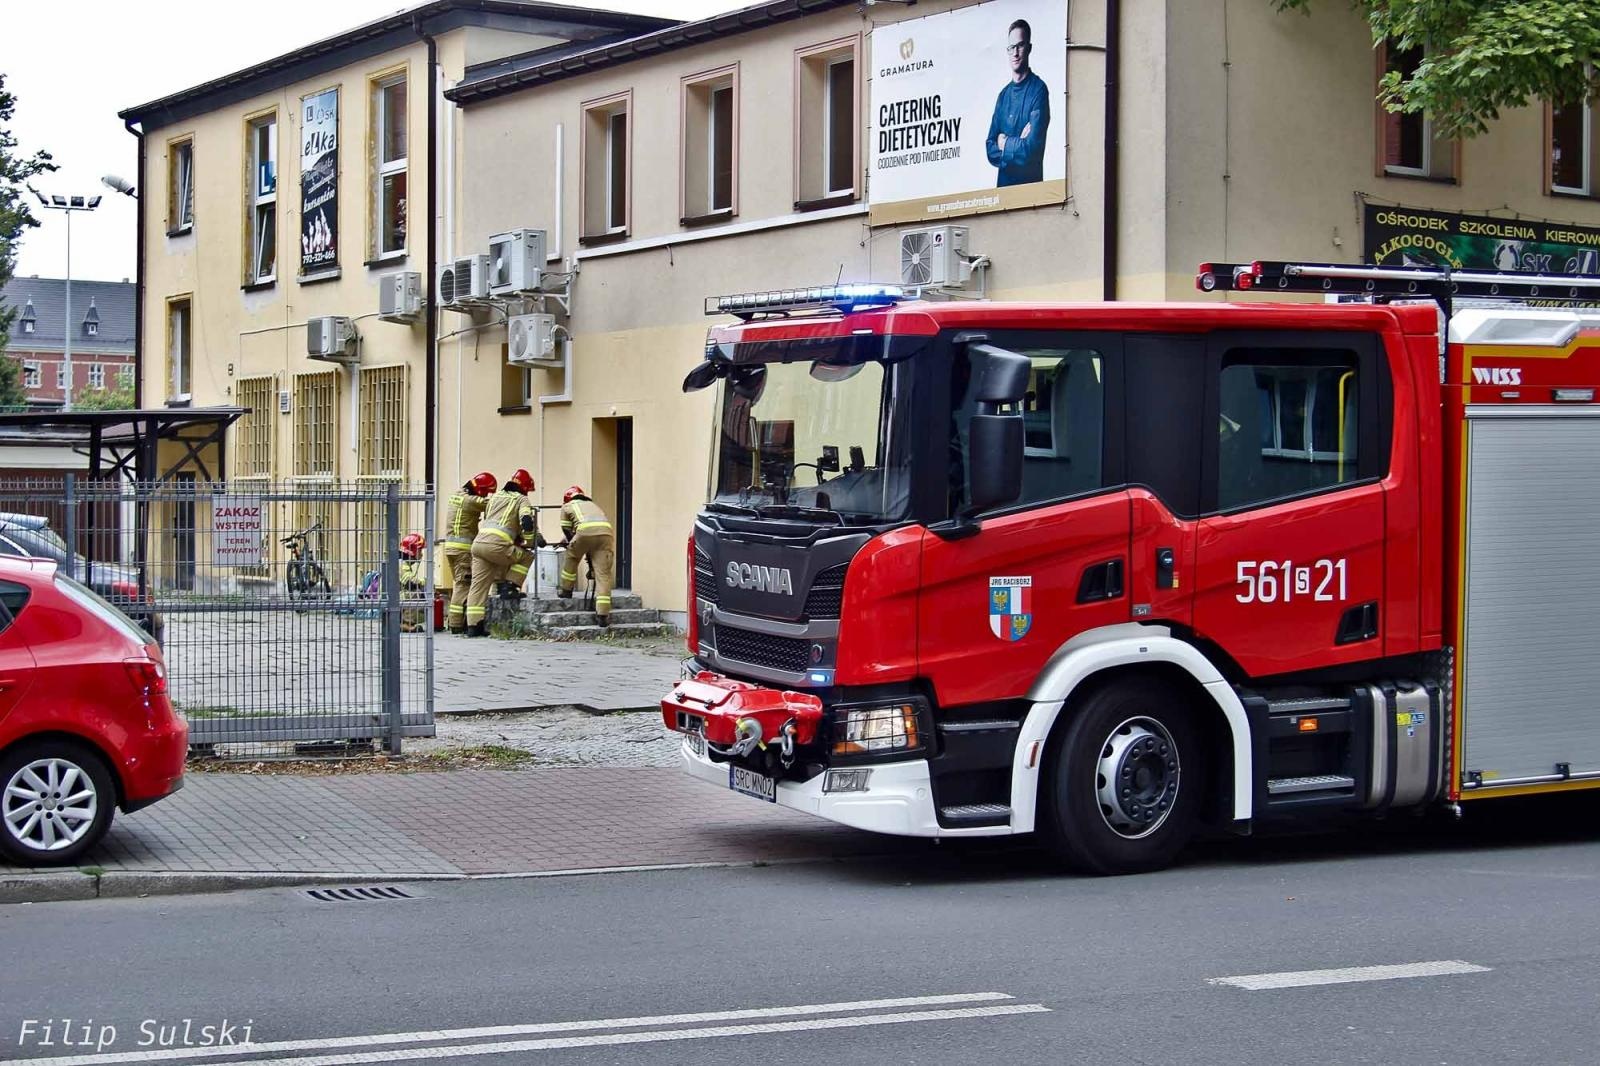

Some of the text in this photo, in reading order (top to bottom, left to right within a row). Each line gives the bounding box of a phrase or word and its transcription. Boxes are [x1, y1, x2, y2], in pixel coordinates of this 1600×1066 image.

[880, 59, 934, 78] GRAMATURA
[879, 94, 941, 128] CATERING
[878, 117, 962, 153] DIETETYCZNY
[878, 154, 909, 170] CODZIENNIE
[909, 152, 922, 165] POD
[922, 149, 941, 163] TWOJE
[1376, 211, 1600, 245] OŚRODEK SZKOLENIA KIEROW
[1472, 368, 1522, 386] WISS
[215, 507, 259, 517] ZAKAZ
[726, 561, 793, 596] SCANIA
[735, 768, 751, 789] SRC
